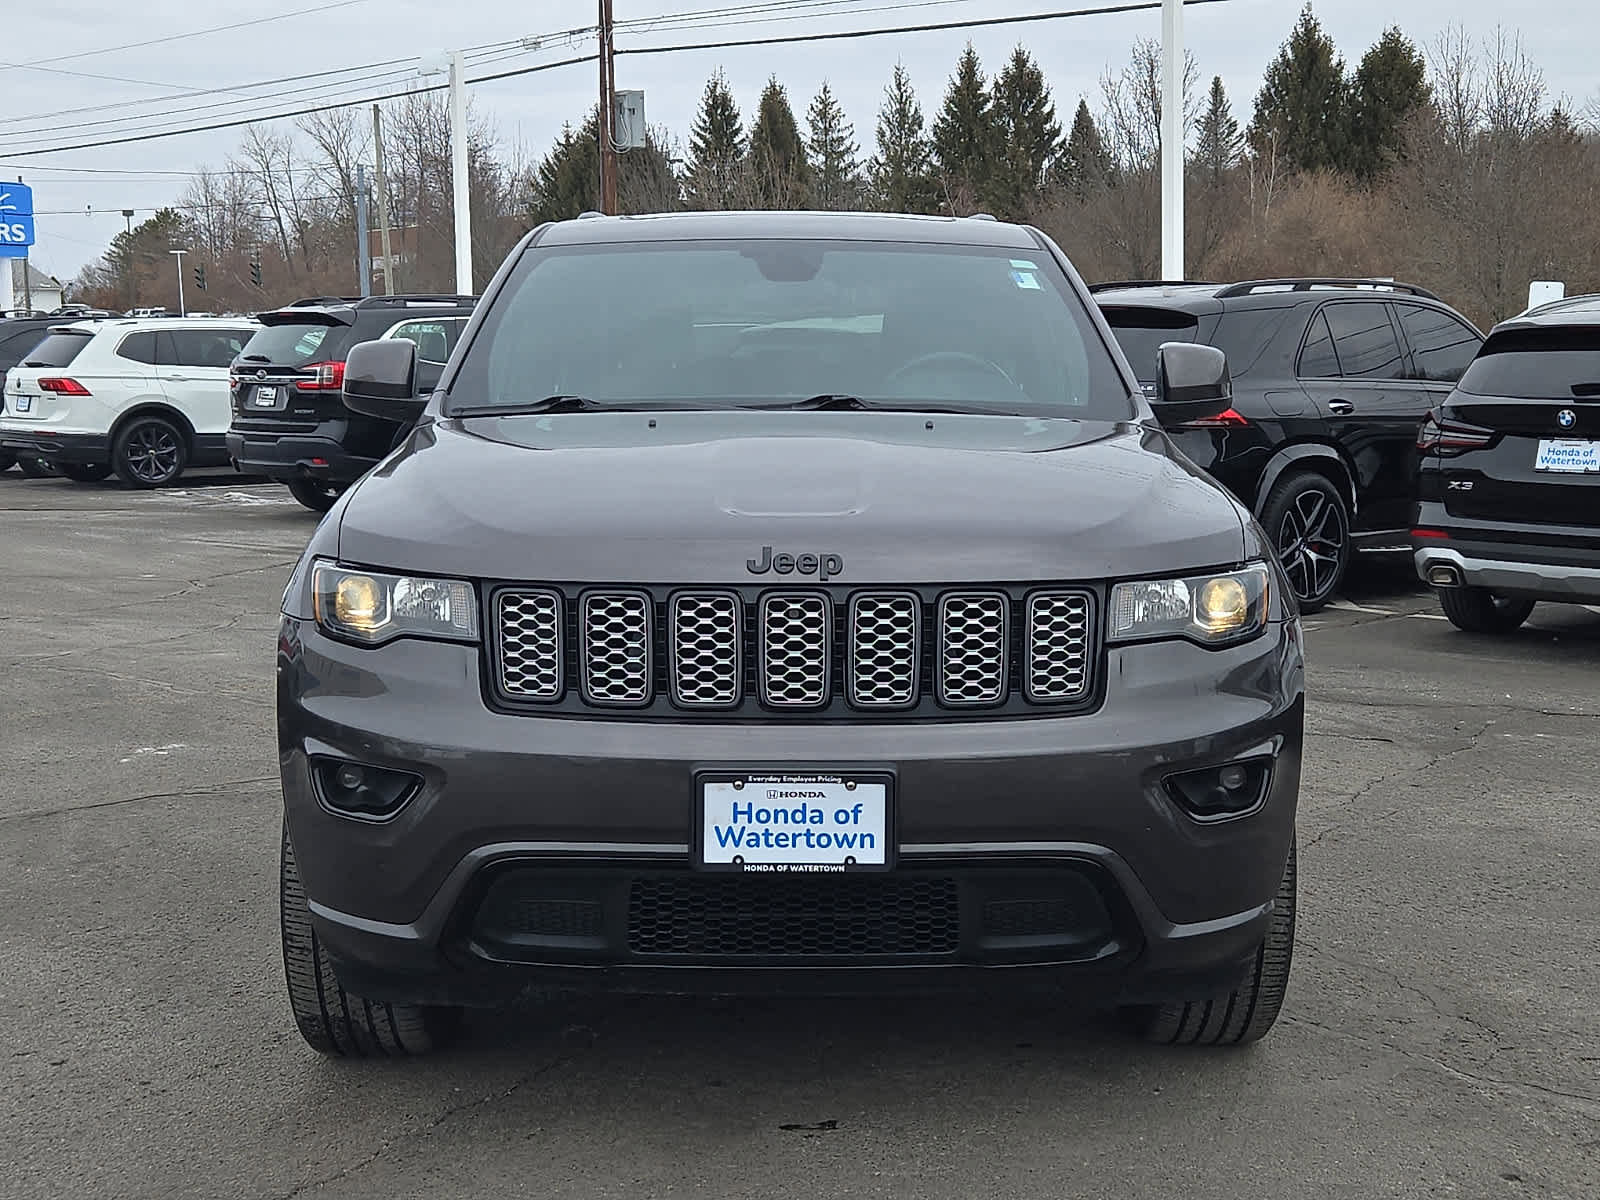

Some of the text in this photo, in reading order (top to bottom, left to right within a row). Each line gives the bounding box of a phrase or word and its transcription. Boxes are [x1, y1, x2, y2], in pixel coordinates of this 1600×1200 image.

[1547, 448, 1593, 457] Honda of
[1540, 456, 1597, 466] Watertown
[1447, 480, 1474, 490] X3
[746, 546, 844, 582] Jeep
[748, 775, 842, 784] Everyday Employee Pricing
[779, 791, 826, 799] HONDA
[732, 802, 863, 825] Honda of
[714, 825, 875, 849] Watertown
[743, 864, 845, 873] HONDA OF WATERTOWN
